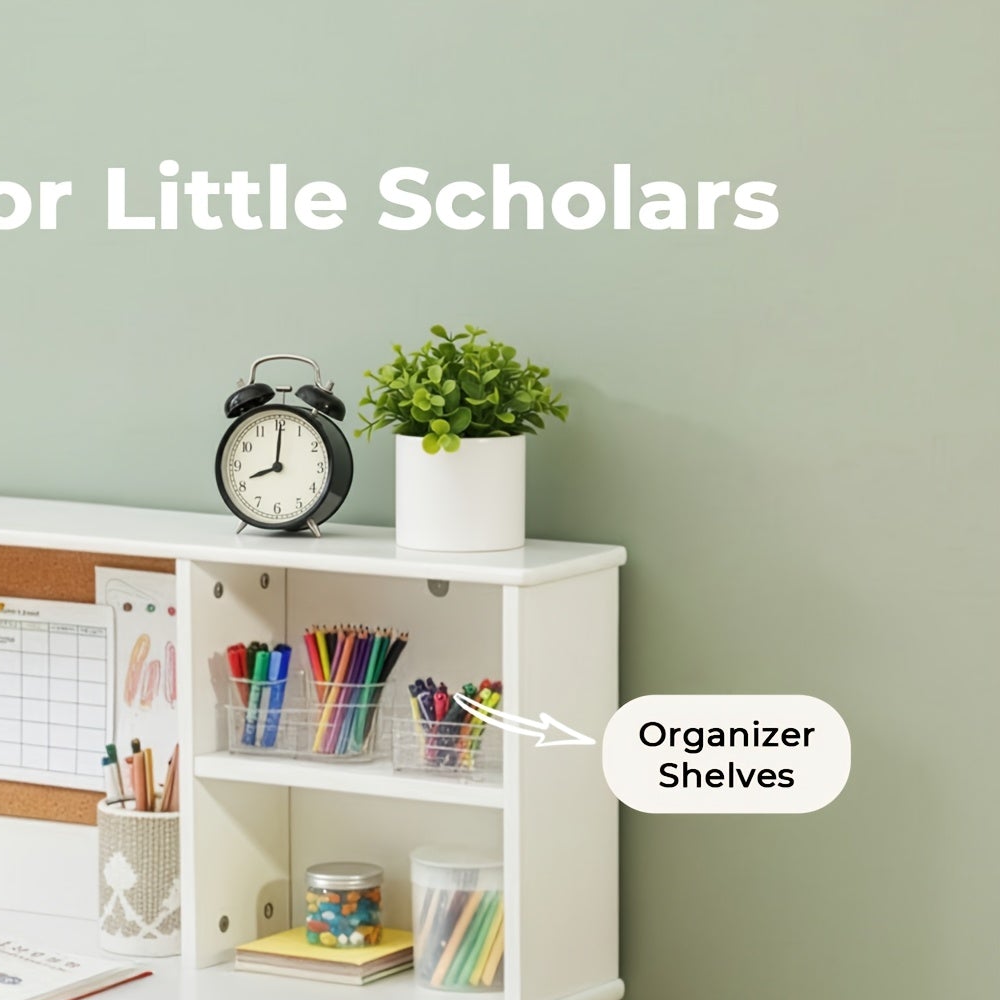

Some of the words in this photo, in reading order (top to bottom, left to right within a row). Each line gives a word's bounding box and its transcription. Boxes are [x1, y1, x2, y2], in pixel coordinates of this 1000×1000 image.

[275, 420, 286, 431] 12
[256, 426, 264, 437] 11
[242, 442, 252, 453] 10
[311, 442, 318, 452] 2
[234, 460, 242, 471] 9
[317, 463, 324, 473] 3
[239, 481, 246, 492] 8
[309, 482, 316, 493] 4
[255, 496, 262, 508] 7
[296, 498, 302, 509] 5
[273, 502, 281, 514] 6
